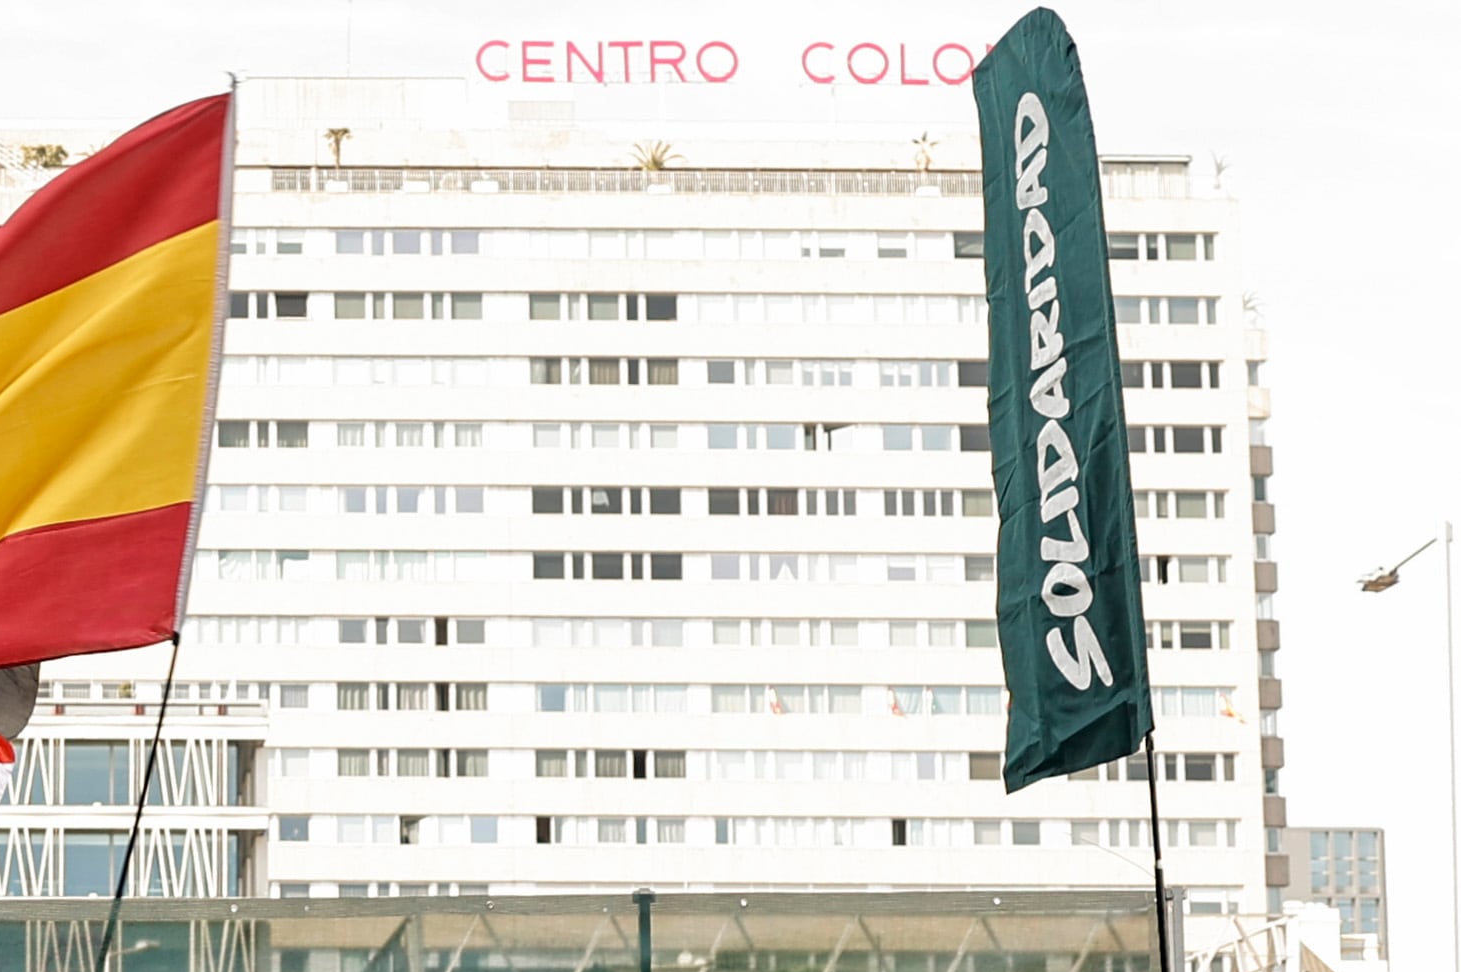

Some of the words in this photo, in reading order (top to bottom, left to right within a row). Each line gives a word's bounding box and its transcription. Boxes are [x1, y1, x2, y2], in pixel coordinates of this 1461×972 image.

[476, 40, 739, 83] CENTRO
[801, 41, 995, 85] COLO
[1014, 92, 1113, 690] SOLIDARIDAD
